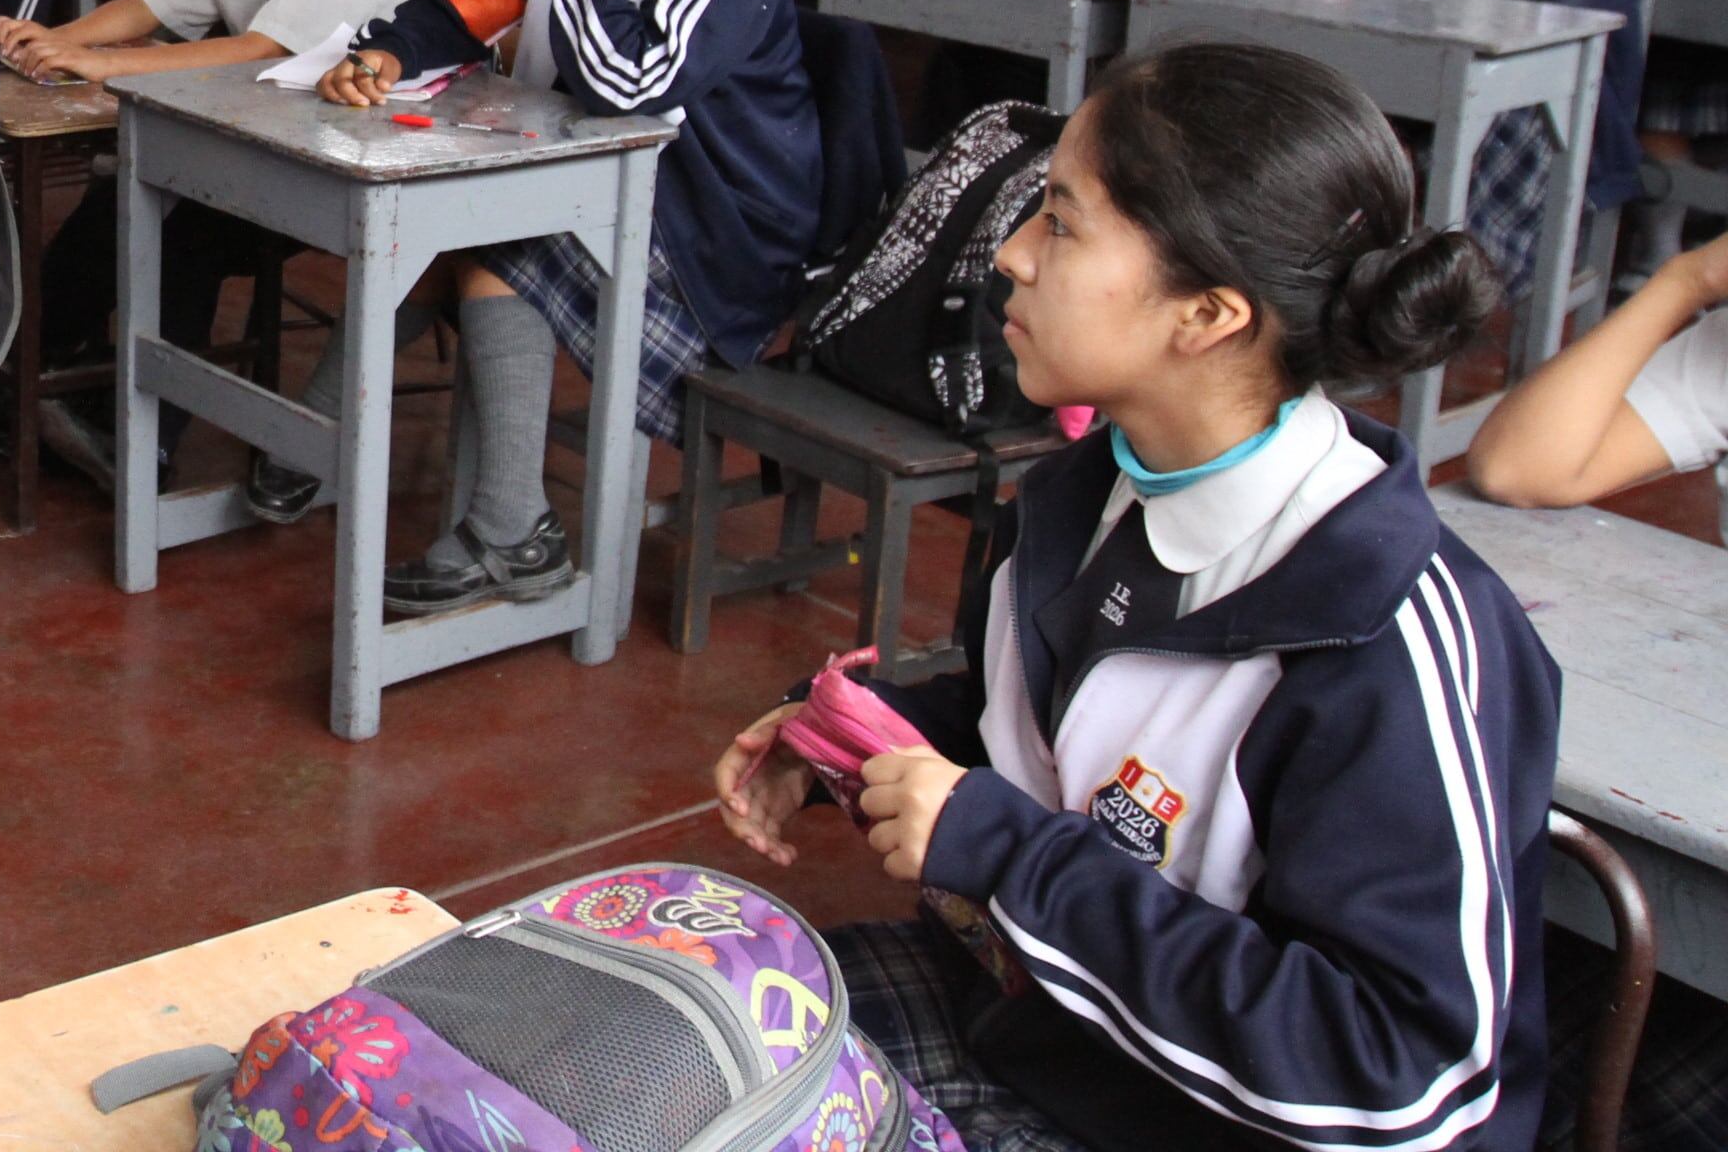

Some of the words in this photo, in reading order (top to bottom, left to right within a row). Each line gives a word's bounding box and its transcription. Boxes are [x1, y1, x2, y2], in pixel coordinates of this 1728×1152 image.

[1099, 598, 1127, 626] 2026
[1106, 786, 1160, 838] 2026
[1158, 795, 1177, 815] E
[1097, 799, 1117, 823] SAN
[1116, 820, 1155, 853] DIEGO
